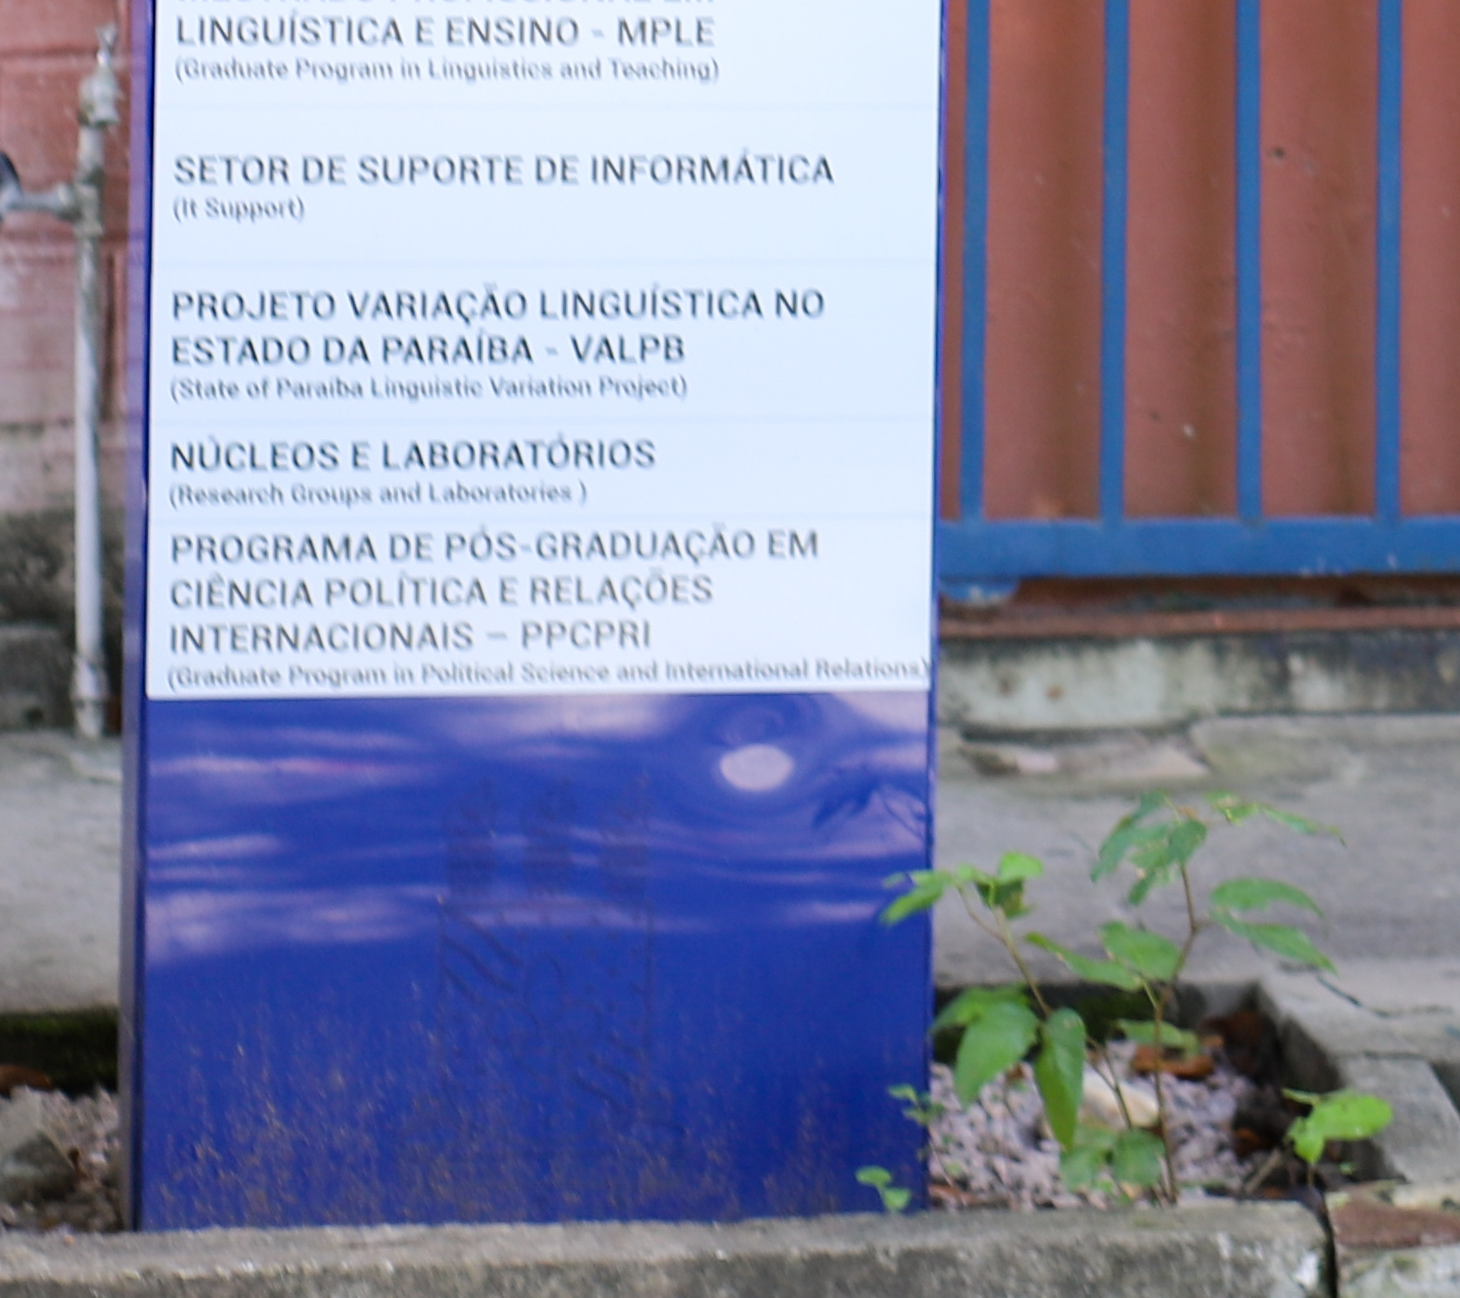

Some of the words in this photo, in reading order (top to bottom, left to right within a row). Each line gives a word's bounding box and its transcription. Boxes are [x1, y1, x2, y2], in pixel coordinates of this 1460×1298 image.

[177, 10, 404, 46] LINGUÍSTICA
[415, 17, 434, 46] E
[446, 17, 579, 46] ENSINO
[618, 17, 714, 47] MPLE
[175, 56, 289, 85] (Graduate
[295, 57, 393, 85] Program
[400, 56, 421, 80] in
[428, 57, 553, 85] Linguistics
[559, 56, 602, 80] and
[608, 56, 719, 85] Teaching)
[174, 155, 290, 185] SETOR
[302, 156, 346, 186] DE
[358, 155, 523, 185] SUPORTE
[535, 155, 579, 185] DE
[591, 148, 834, 185] INFORMÁTICA
[204, 195, 305, 224] Support)
[172, 290, 336, 321] PROJETO
[347, 283, 527, 328] VARIAÇÃO
[540, 283, 764, 320] LINGUÍSTICA
[775, 288, 825, 319] NO
[172, 336, 311, 367] ESTADO
[323, 336, 371, 365] DA
[382, 329, 534, 365] PARAÍBA
[570, 333, 685, 364] VALPB
[170, 376, 240, 405] (State
[246, 376, 270, 400] of
[370, 375, 483, 404] Linguistic
[489, 374, 592, 398] Variation
[599, 373, 688, 402] Project)
[171, 434, 339, 471] NÚCLEOS
[351, 441, 370, 471] E
[382, 433, 655, 470] LABORATÓRIOS
[169, 482, 284, 511] (Research
[291, 481, 373, 509] Groups
[379, 480, 422, 504] and
[429, 480, 572, 504] Laboratories
[171, 534, 377, 564] PROGRAMA
[389, 533, 433, 562] DE
[445, 524, 755, 567] PÓS-GRADUAÇÃO
[768, 529, 818, 559] EM
[170, 572, 313, 609] CIÊNCIA
[325, 571, 487, 607] POLÍTICA
[499, 576, 517, 606] E
[530, 571, 713, 611] RELAÇÕES
[170, 622, 473, 653] INTERNACIONAIS
[522, 620, 650, 648] PPCPRI
[168, 664, 281, 691] (Graduate
[288, 662, 387, 689] Program
[394, 662, 414, 684] in
[421, 661, 514, 684] Political
[521, 660, 610, 683] Science
[617, 659, 659, 681] and
[666, 657, 809, 681] International
